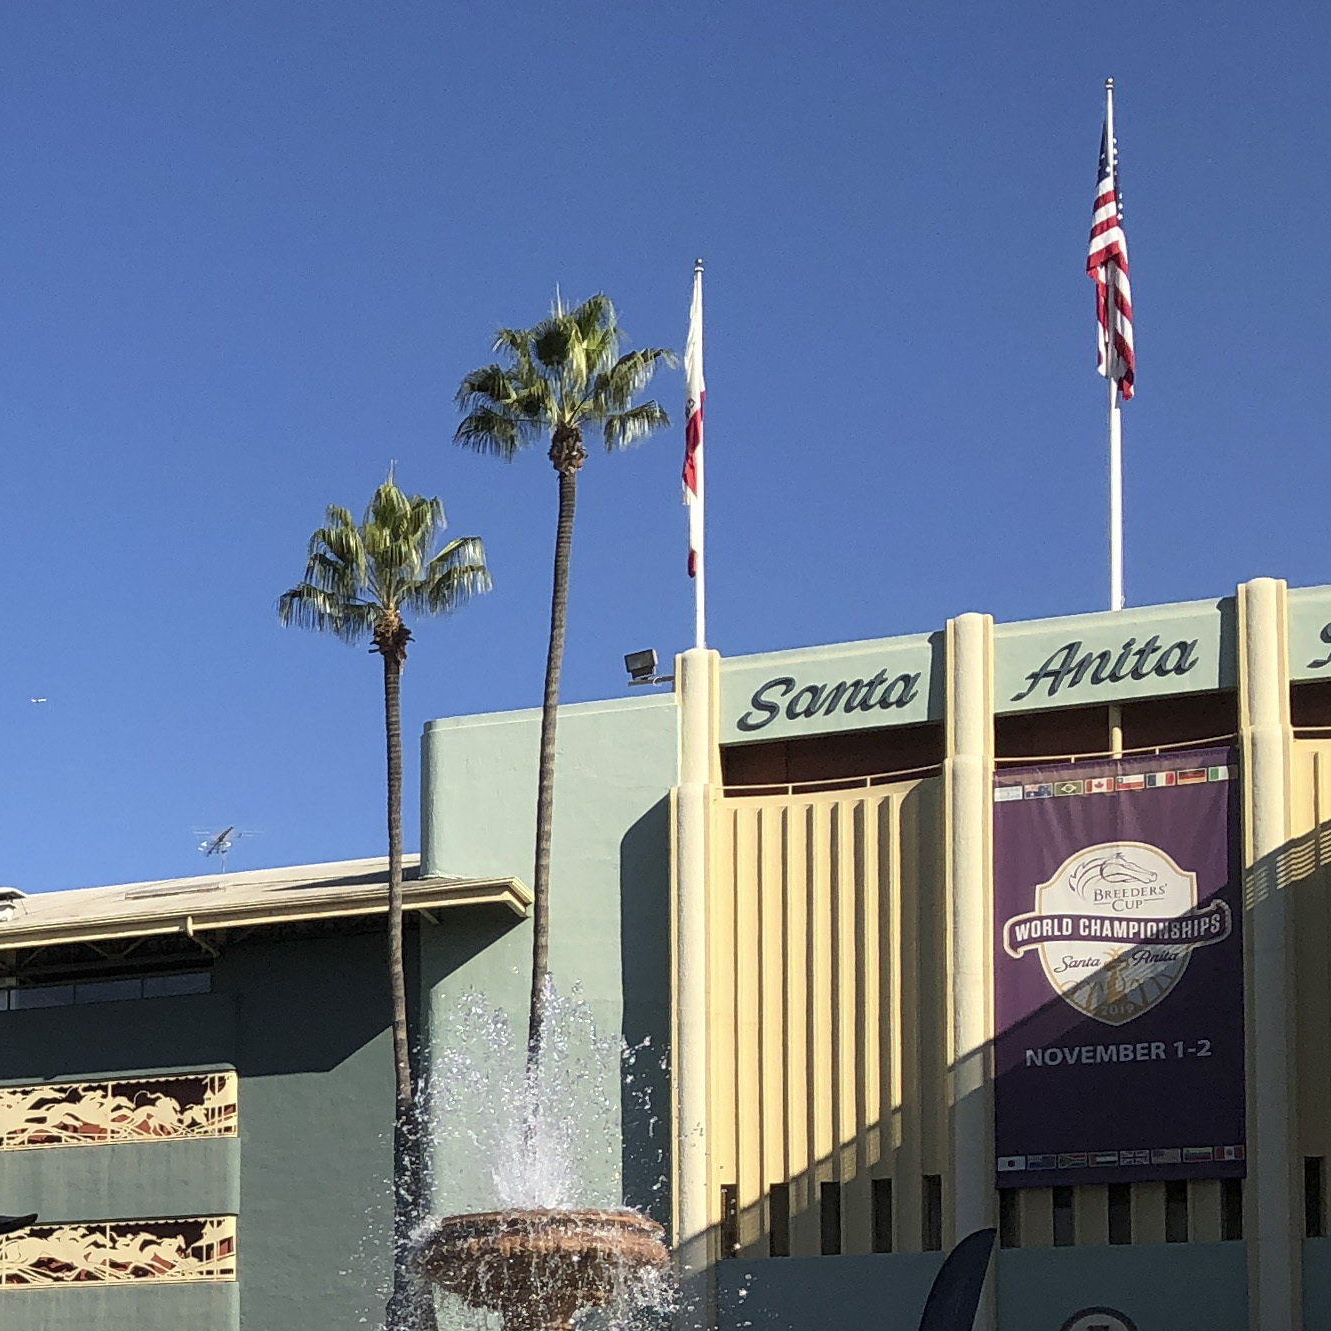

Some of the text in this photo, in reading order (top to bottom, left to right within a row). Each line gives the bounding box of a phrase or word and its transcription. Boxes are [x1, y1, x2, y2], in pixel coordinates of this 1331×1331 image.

[736, 634, 1200, 732] Santa Anita
[1015, 913, 1222, 942] WORLD CHAMPIONSHIPS
[1054, 950, 1180, 974] Santa Anita
[1101, 1004, 1135, 1016] 2019
[1025, 1039, 1212, 1067] NOVEMBER 1-2
